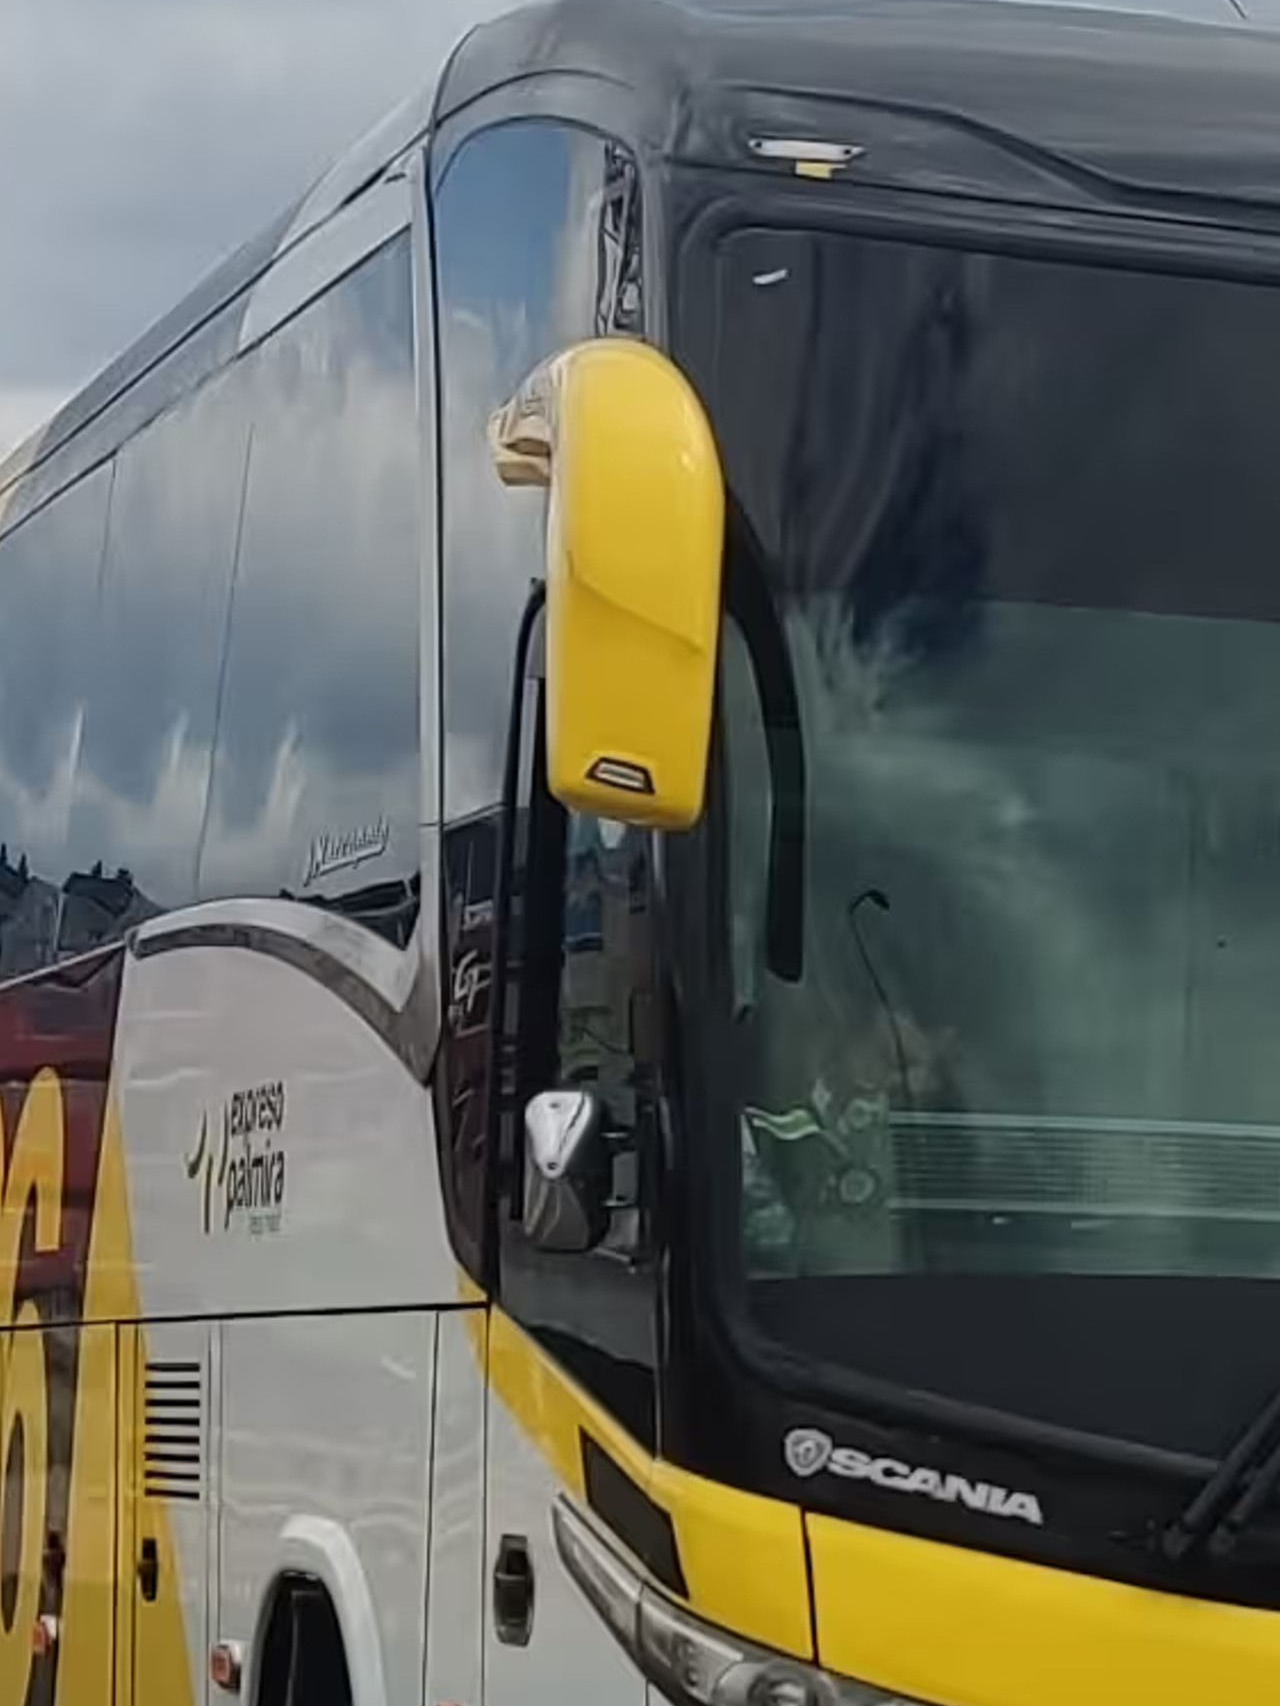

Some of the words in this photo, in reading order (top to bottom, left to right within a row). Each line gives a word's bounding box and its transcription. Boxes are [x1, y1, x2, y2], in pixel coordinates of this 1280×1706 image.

[231, 1081, 284, 1146] expreso
[224, 1139, 285, 1231] palmira
[826, 1447, 1043, 1525] SCANIA
